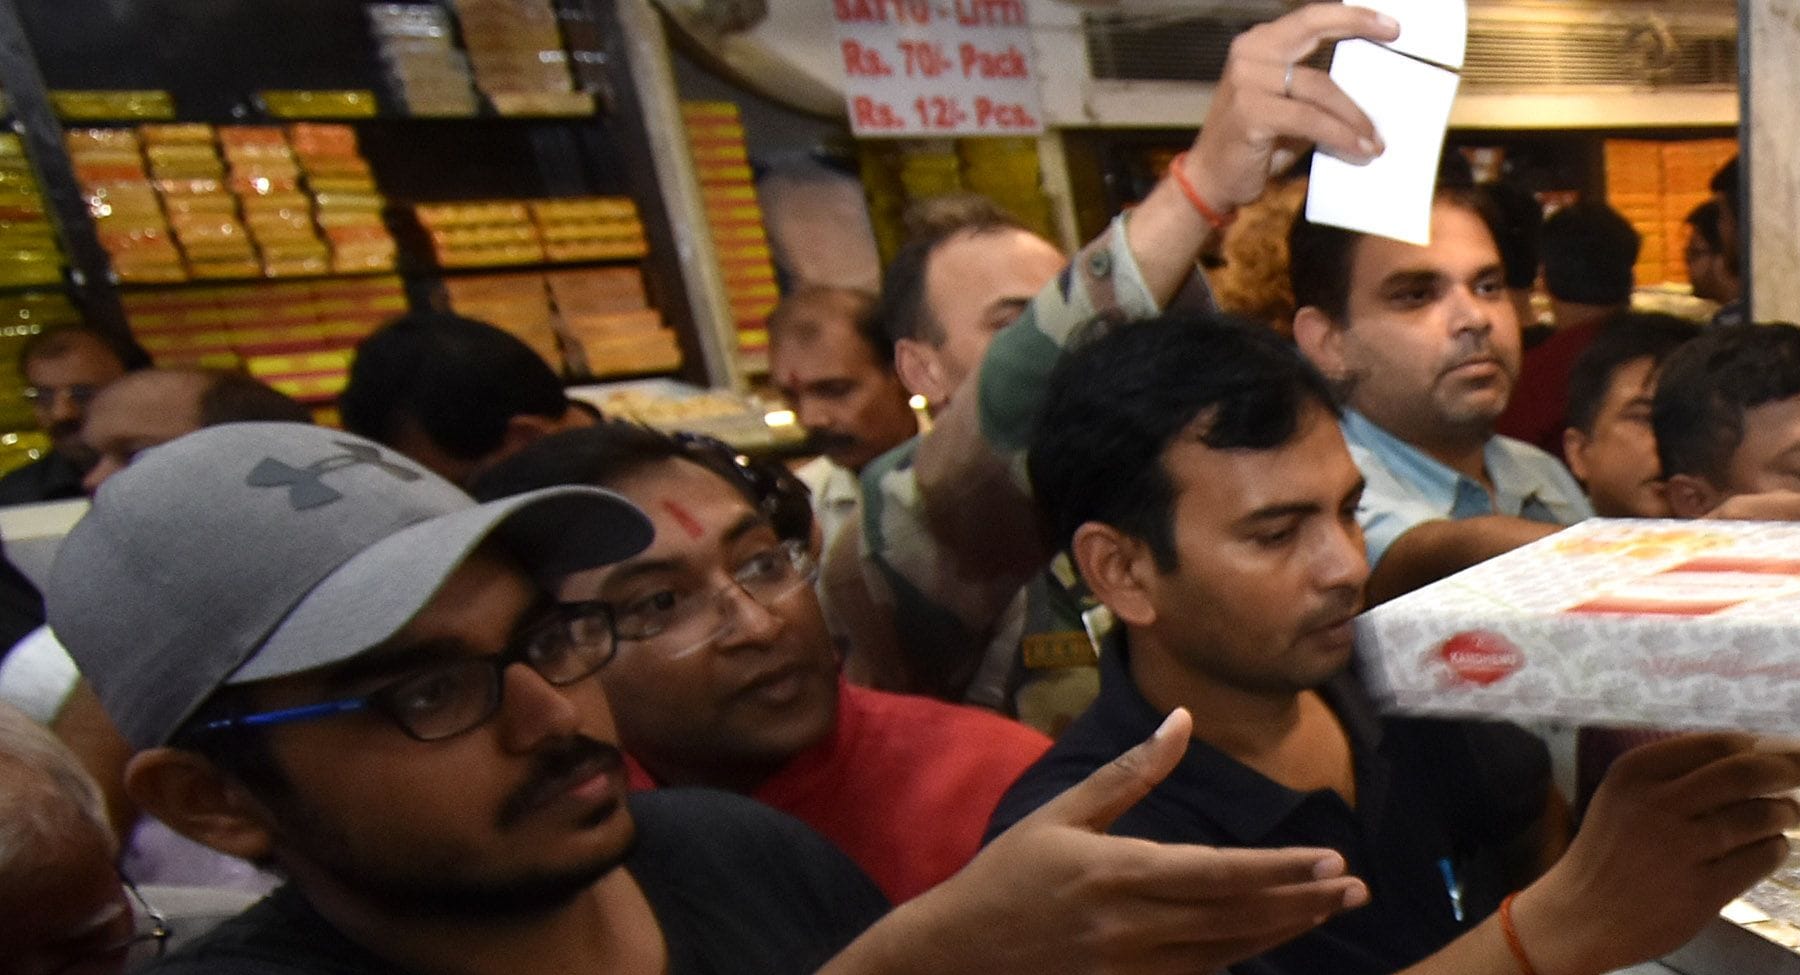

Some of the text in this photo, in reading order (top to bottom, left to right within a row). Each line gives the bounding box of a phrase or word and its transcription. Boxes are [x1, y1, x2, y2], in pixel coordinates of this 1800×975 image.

[841, 37, 893, 78] Rs.
[959, 41, 1029, 79] Pack
[852, 95, 906, 128] Rs.
[974, 95, 1038, 128] Pcs.
